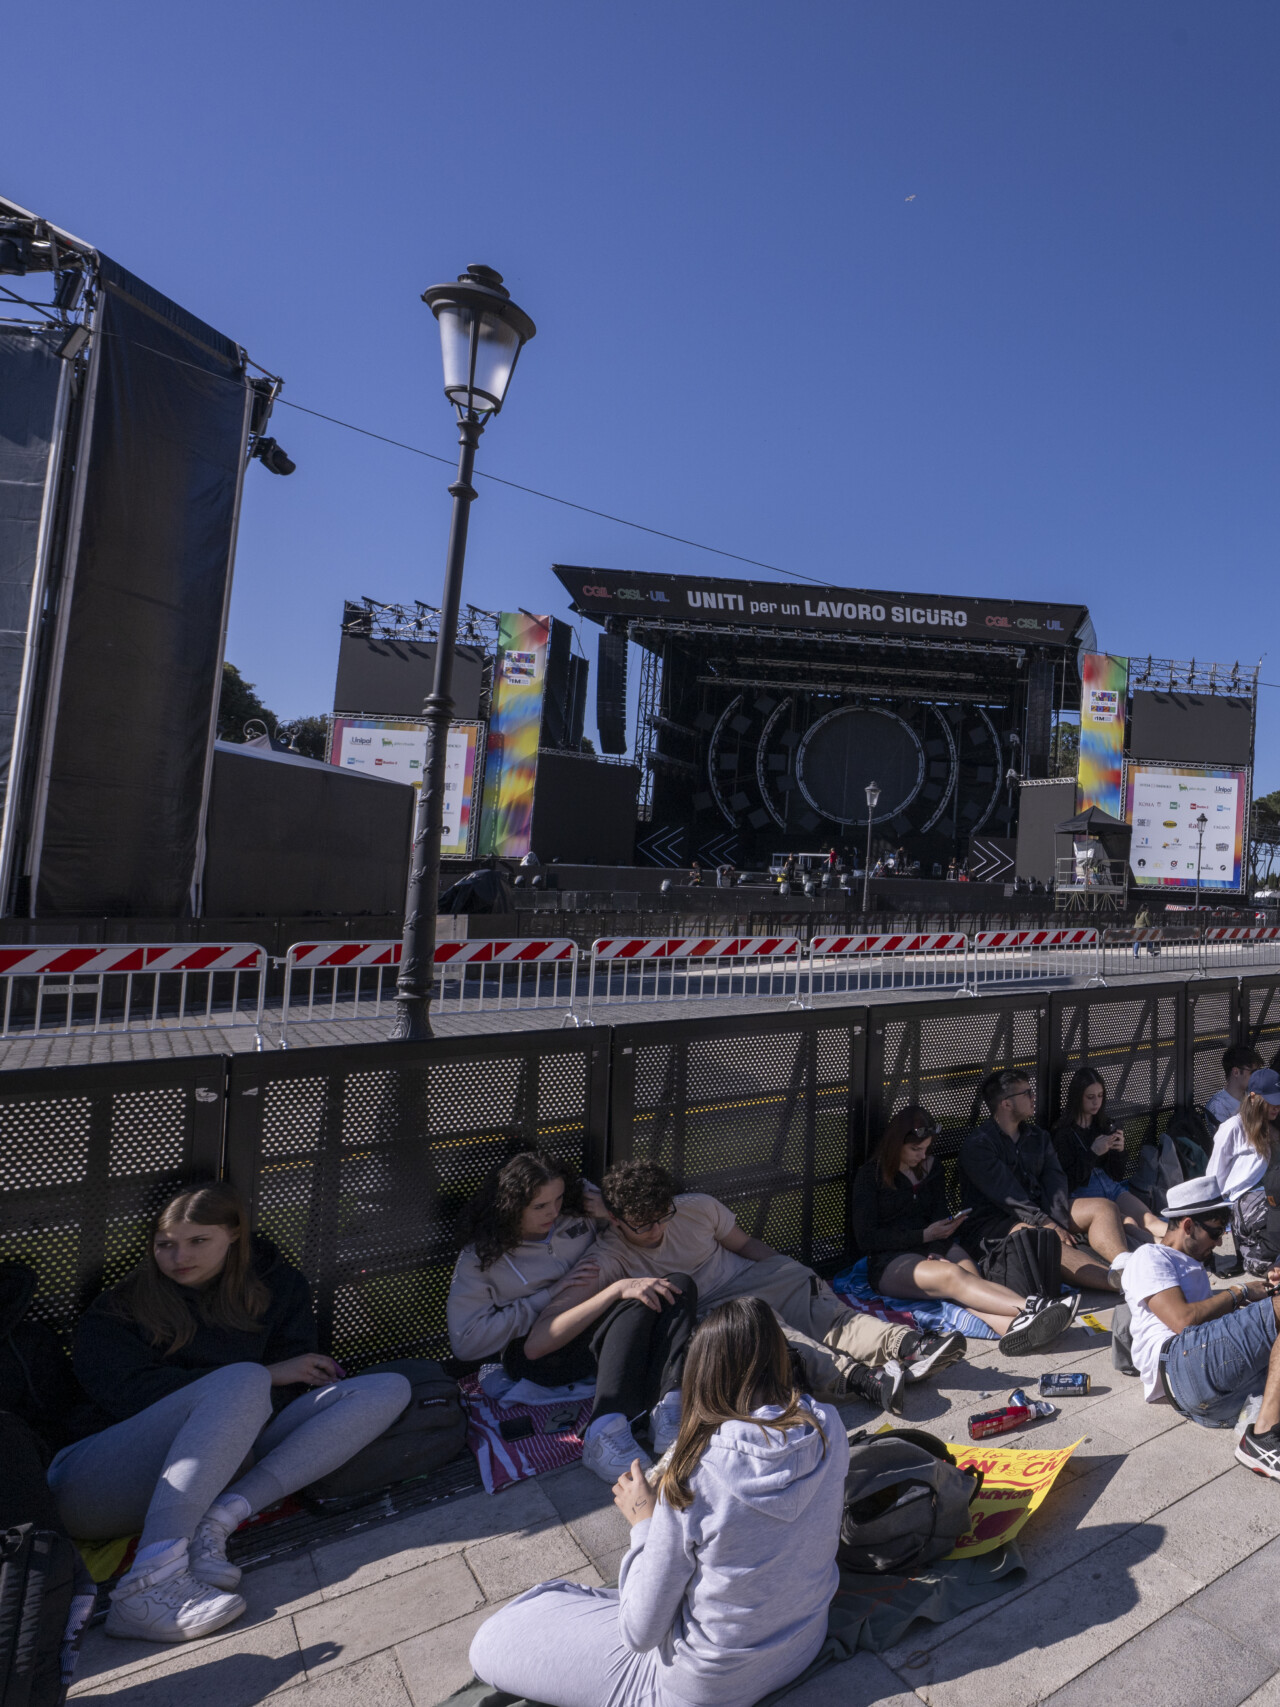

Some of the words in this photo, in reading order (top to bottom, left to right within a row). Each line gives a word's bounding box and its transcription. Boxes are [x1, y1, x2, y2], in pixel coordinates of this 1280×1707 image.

[582, 585, 613, 598] CGIL
[617, 587, 646, 600] CISL
[650, 590, 670, 602] UIL
[687, 590, 745, 611] UNITI
[750, 601, 778, 615] per
[781, 604, 800, 615] un
[805, 600, 886, 622] LAVORO
[891, 606, 968, 627] SICURO
[985, 615, 1012, 628] CGIL
[1016, 617, 1042, 630] CISL
[1046, 619, 1064, 631] UIL
[351, 736, 372, 745] Unipol
[1215, 785, 1232, 794] Unipol
